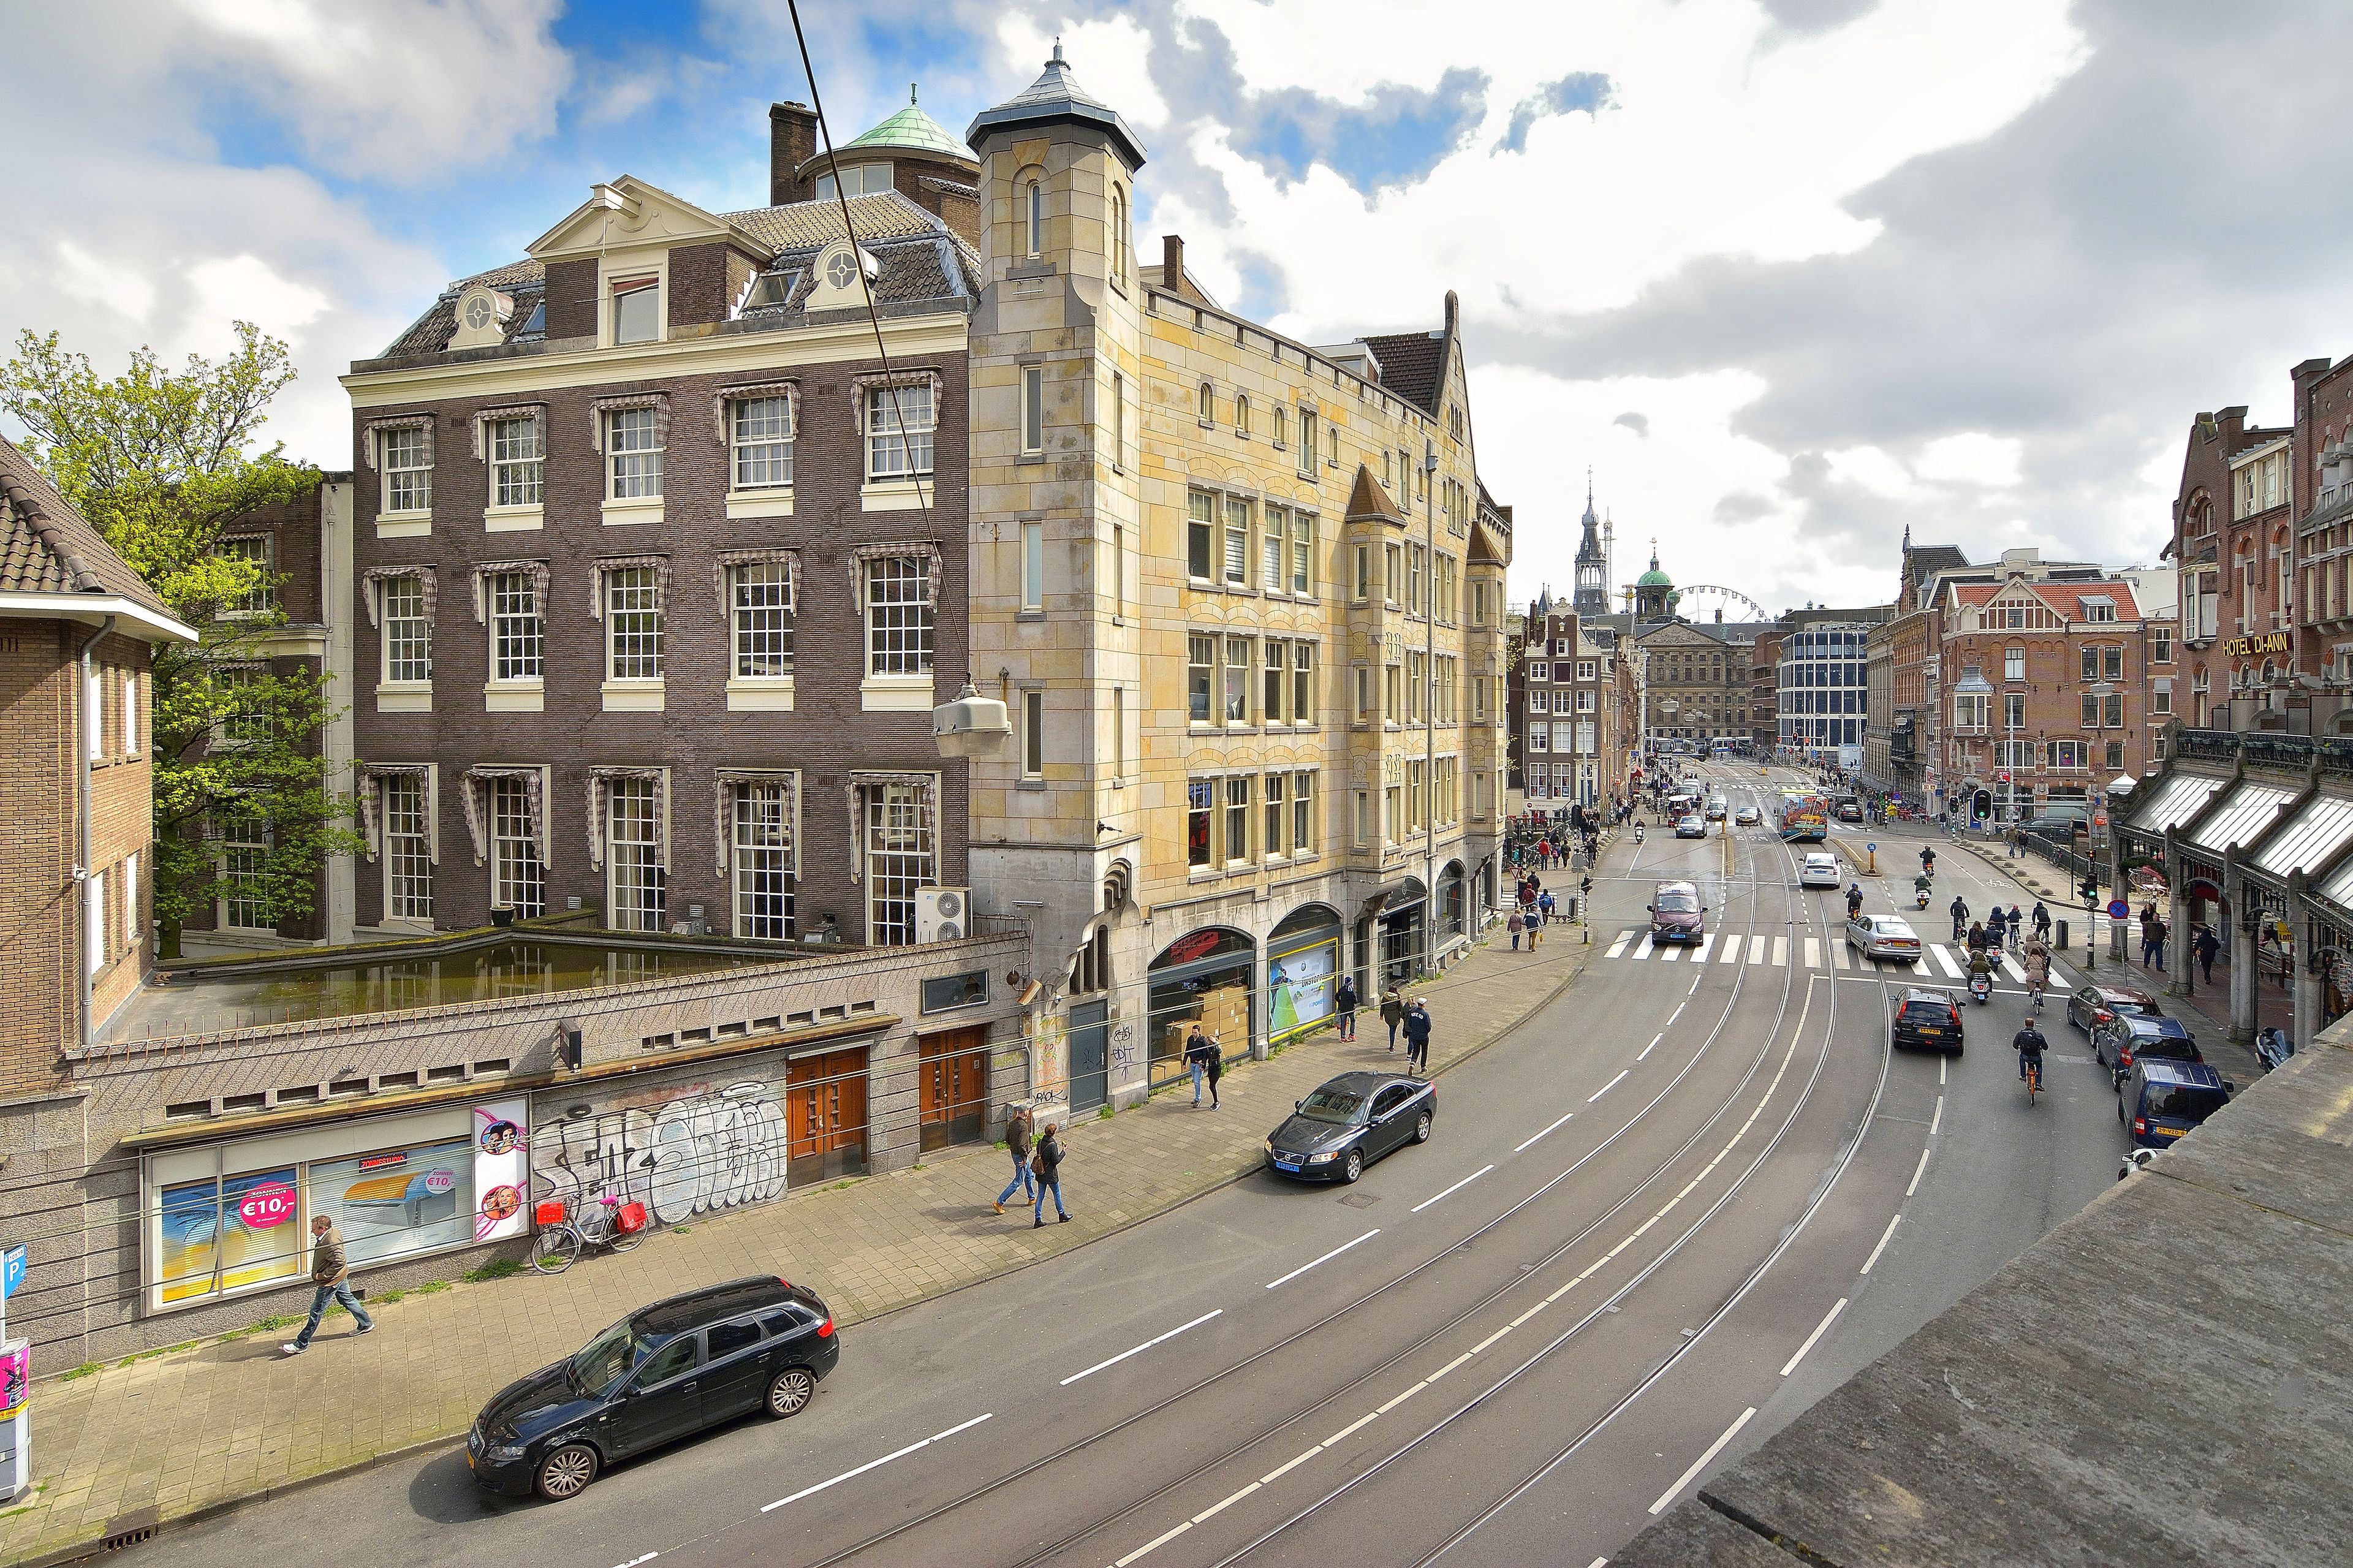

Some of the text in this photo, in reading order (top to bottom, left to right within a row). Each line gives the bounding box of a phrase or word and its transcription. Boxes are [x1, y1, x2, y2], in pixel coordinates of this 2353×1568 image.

[2222, 633, 2287, 656] HOTEL DI-ANN
[250, 1188, 286, 1199] ZONNEN
[10, 1249, 23, 1260] 10519
[10, 1262, 19, 1282] P
